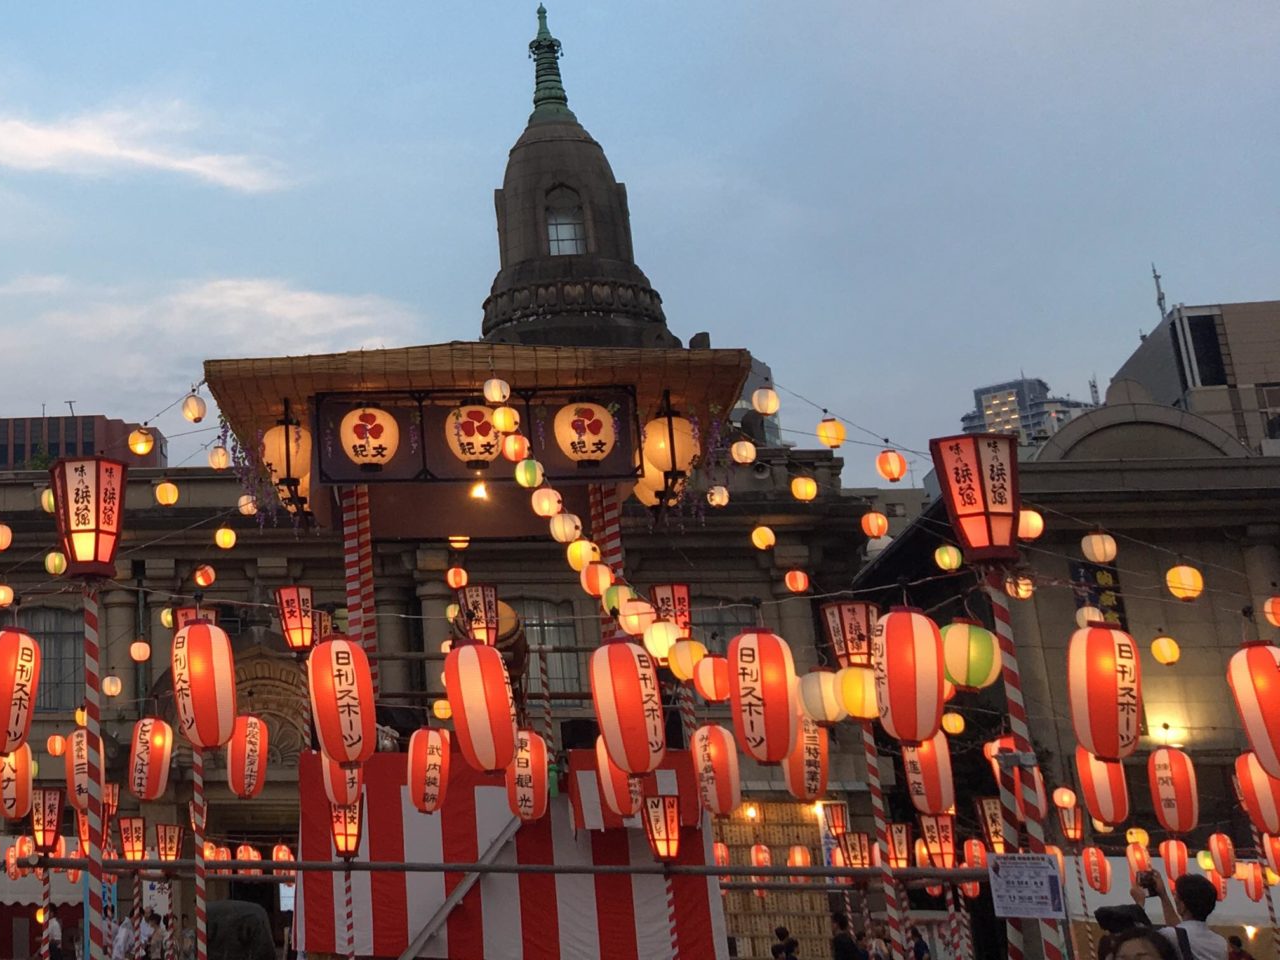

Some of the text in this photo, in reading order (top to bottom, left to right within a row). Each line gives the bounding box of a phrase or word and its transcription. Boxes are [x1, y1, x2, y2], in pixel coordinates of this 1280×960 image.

[352, 444, 388, 458] 紀文
[460, 442, 495, 456] 紀文
[571, 440, 608, 454] 紀文
[285, 598, 298, 619] 紀文
[301, 597, 311, 619] 紀文
[660, 596, 674, 618] 紀文
[677, 596, 688, 618] 紀文
[173, 635, 195, 730] 日刊スポーツ
[871, 623, 889, 719] 日刊スポーツ
[8, 646, 34, 743] 日刊スポーツ
[333, 650, 362, 748] 日刊スポーツ
[637, 653, 664, 754] 日刊スポーツ
[738, 647, 765, 749] 日刊スポーツ
[1116, 642, 1138, 748] 日刊スポーツ
[0, 760, 18, 810] ハナワ
[74, 762, 89, 797] 三和
[422, 744, 443, 803] 武内装飾
[515, 737, 534, 809] 東日観光
[47, 801, 57, 828] 紫水
[134, 826, 143, 843] 紀文
